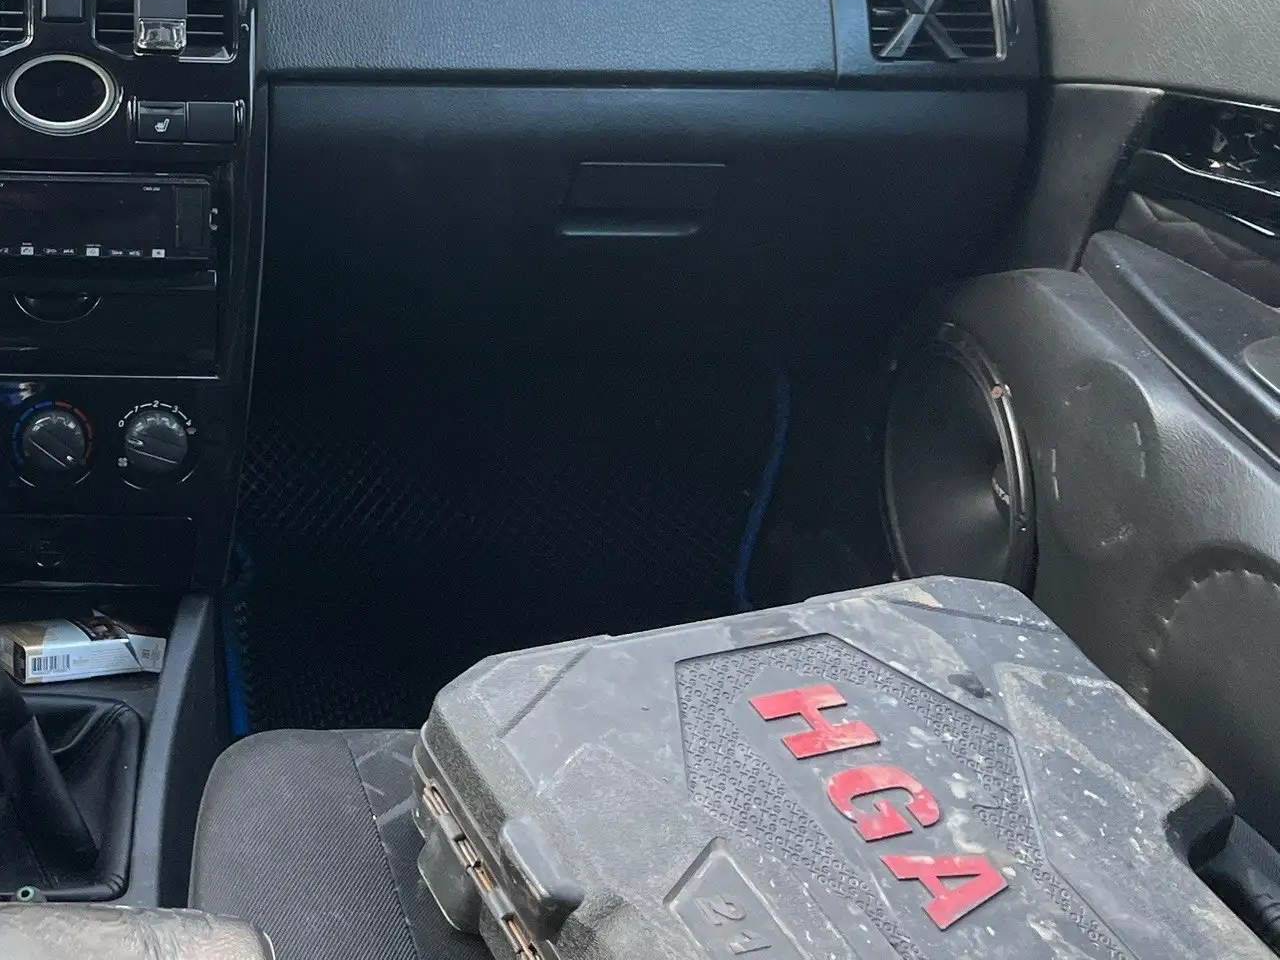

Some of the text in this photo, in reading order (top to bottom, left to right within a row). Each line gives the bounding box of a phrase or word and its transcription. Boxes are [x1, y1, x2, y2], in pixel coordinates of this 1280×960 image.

[118, 420, 125, 428] 0
[134, 405, 139, 413] 1
[152, 400, 160, 408] 2
[172, 405, 179, 413] 3
[749, 683, 1009, 931] HGA
